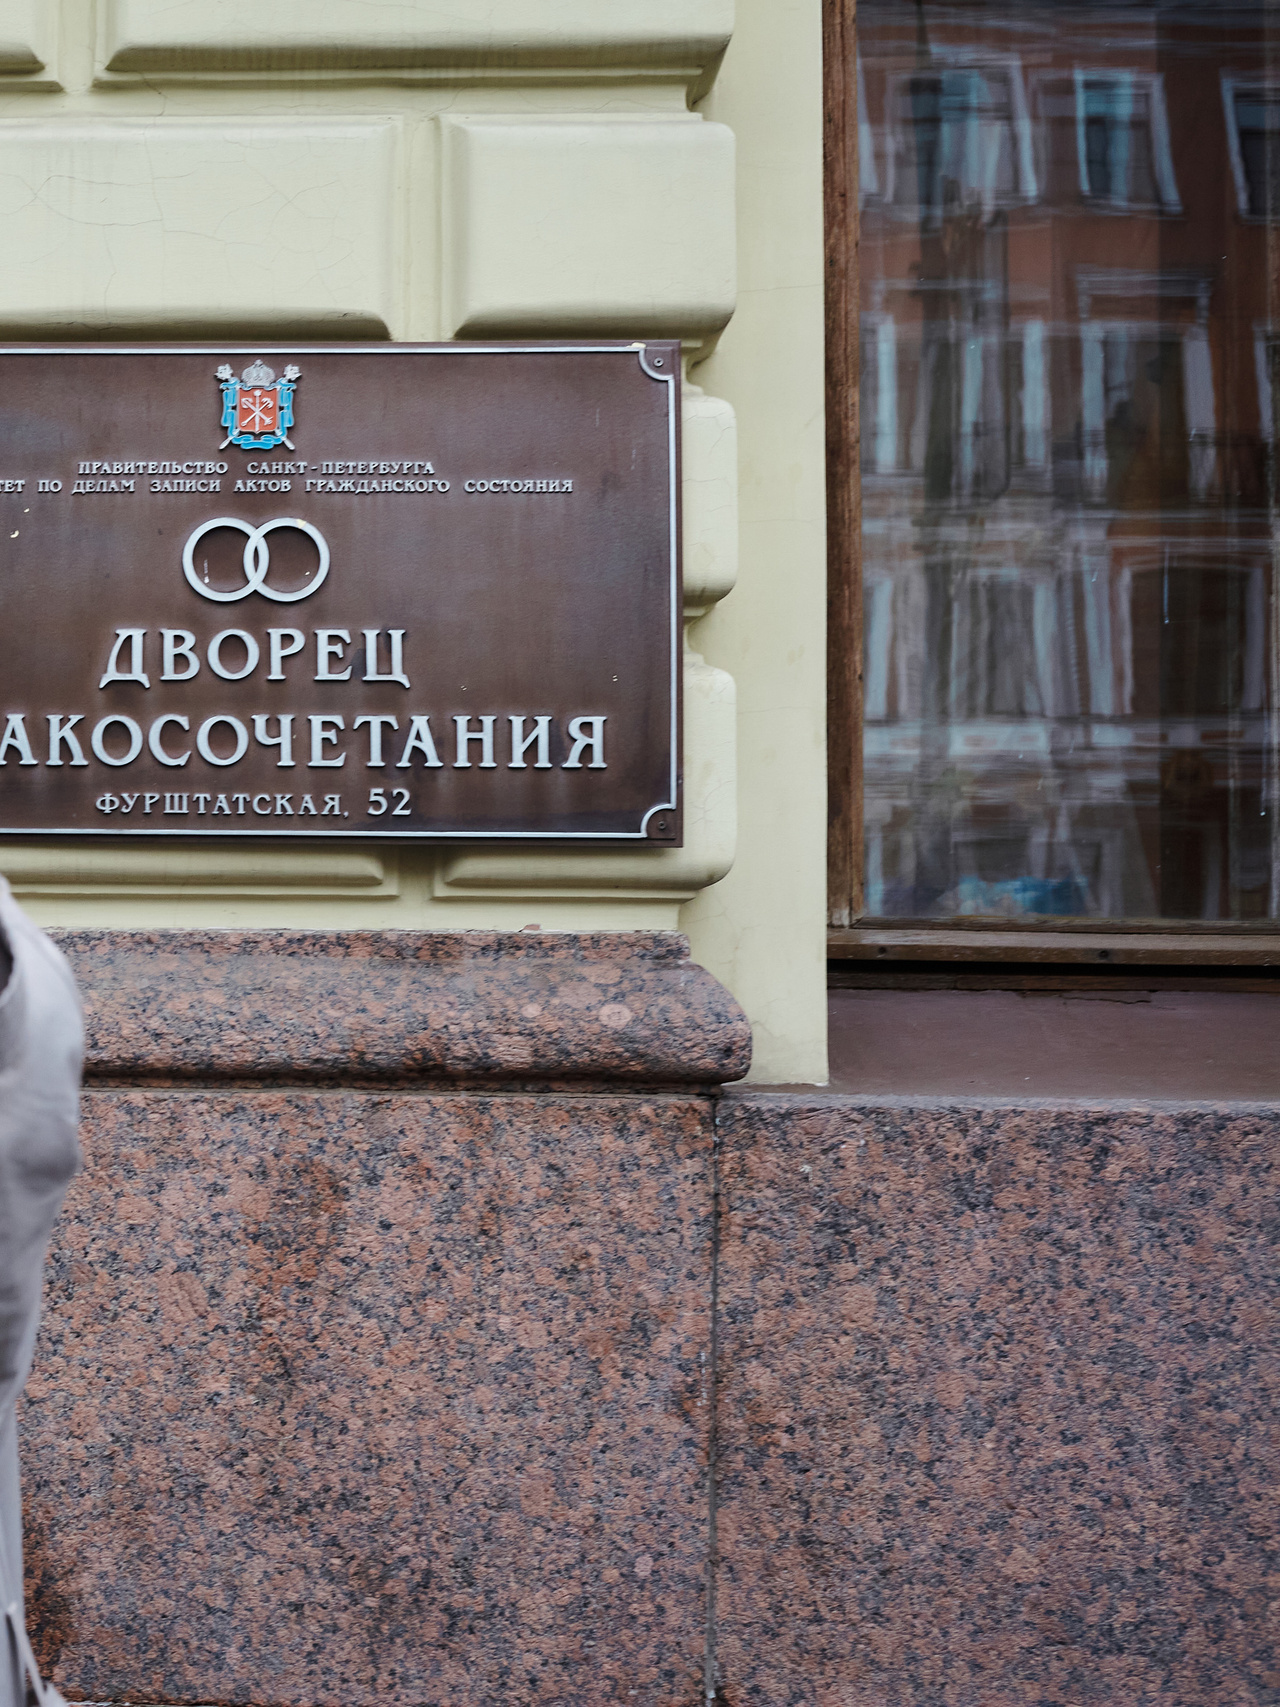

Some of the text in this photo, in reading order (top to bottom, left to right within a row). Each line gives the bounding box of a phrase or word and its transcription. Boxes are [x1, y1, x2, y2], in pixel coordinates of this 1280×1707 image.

[78, 461, 435, 475] ПРАВИТЕЛЬСТВО САНКТ-ПЕТЕРБУРГА
[37, 479, 62, 493] ПО
[72, 479, 135, 495] ДЕЛАМ
[150, 479, 222, 493] ЗАПИСИ
[233, 479, 292, 493] АКТОВ
[304, 479, 450, 495] ГРАЖДАНСКОГО
[464, 479, 574, 493] СОСТОЯНИЯ
[99, 628, 411, 689] ДВОРЕЦ
[95, 788, 413, 818] ФУРШТАТСКАЯ, 52
